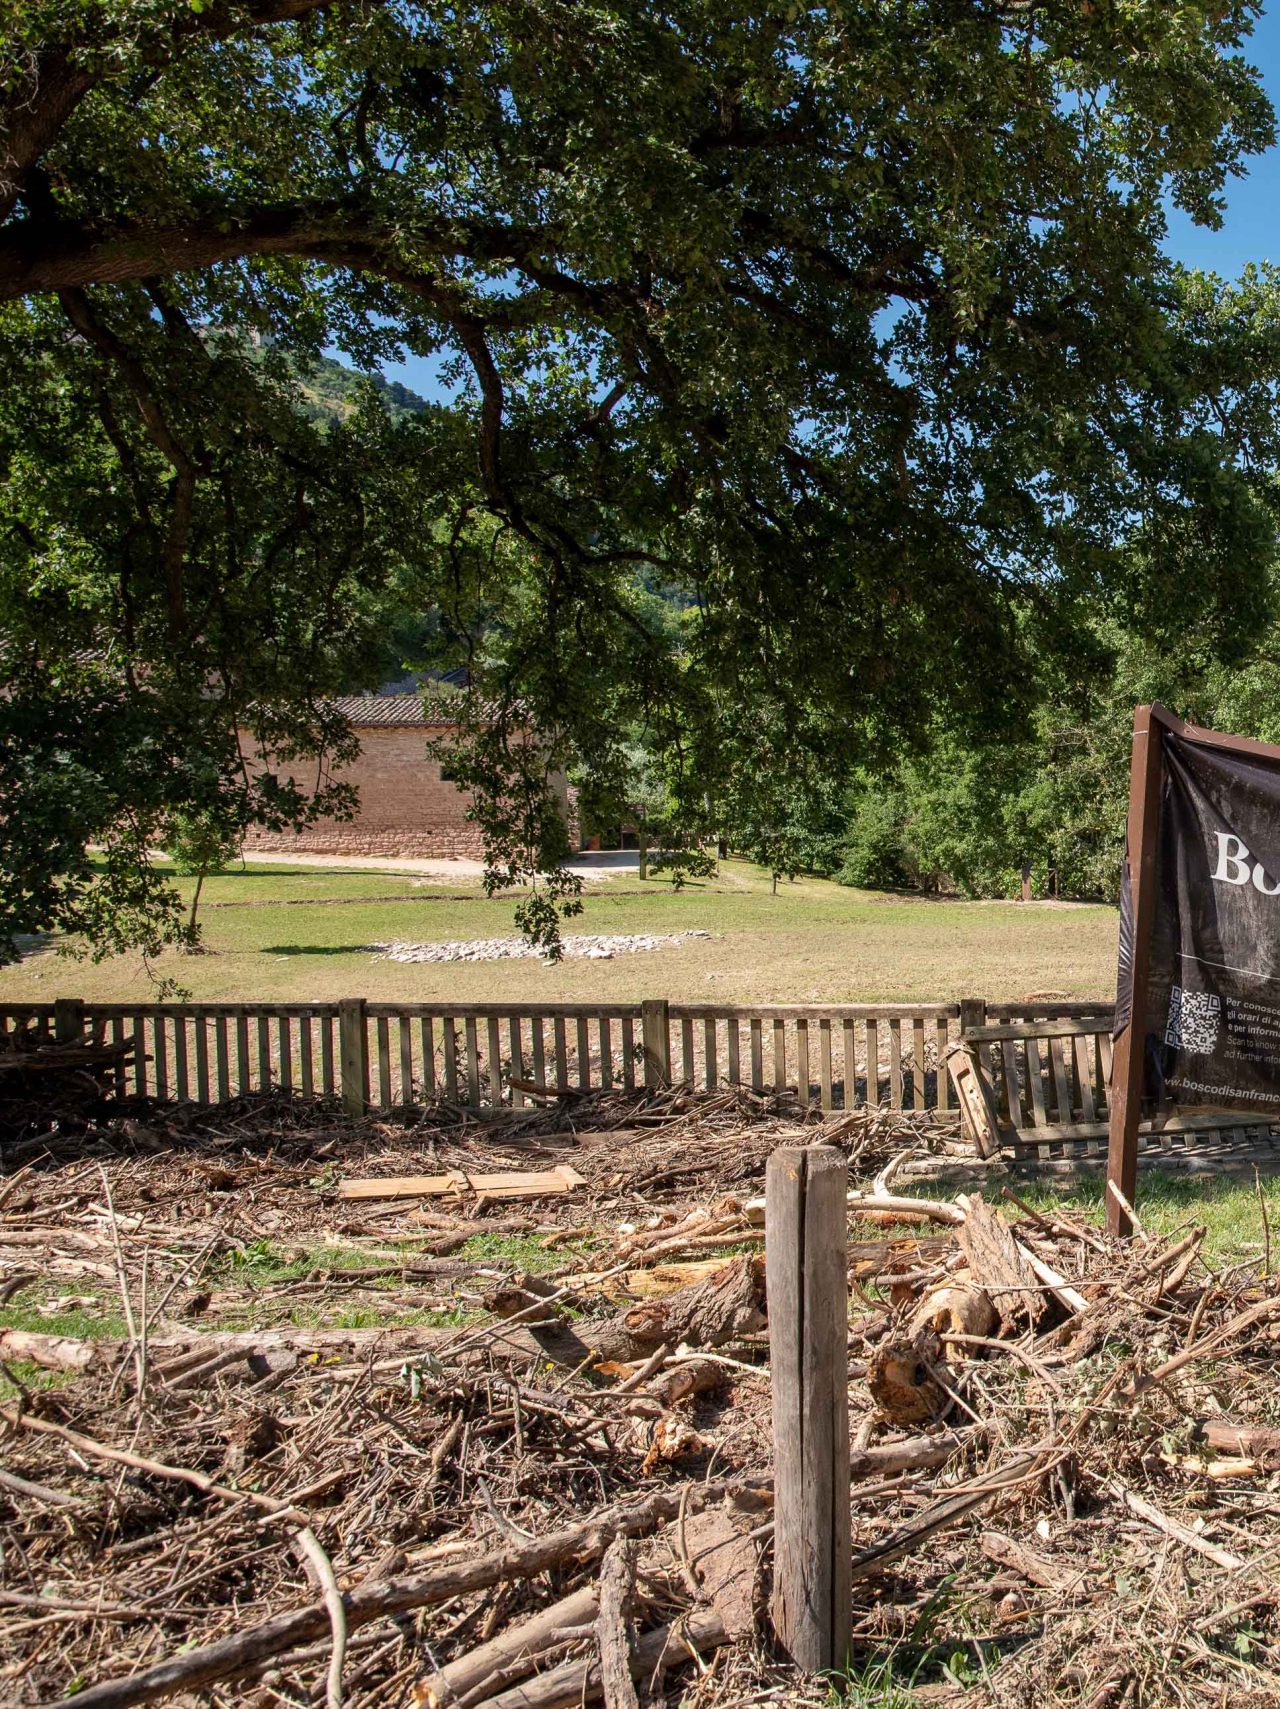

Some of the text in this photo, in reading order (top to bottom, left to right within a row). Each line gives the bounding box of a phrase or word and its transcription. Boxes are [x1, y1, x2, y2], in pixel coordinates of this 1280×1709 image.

[1225, 997, 1241, 1007] Per
[1227, 1010, 1236, 1020] gli
[1237, 1013, 1260, 1023] orari
[1261, 1016, 1271, 1025] di
[1228, 1023, 1233, 1031] e
[1234, 1024, 1247, 1034] per
[1227, 1035, 1246, 1046] Scan
[1246, 1037, 1254, 1048] to
[1236, 1050, 1264, 1063] further
